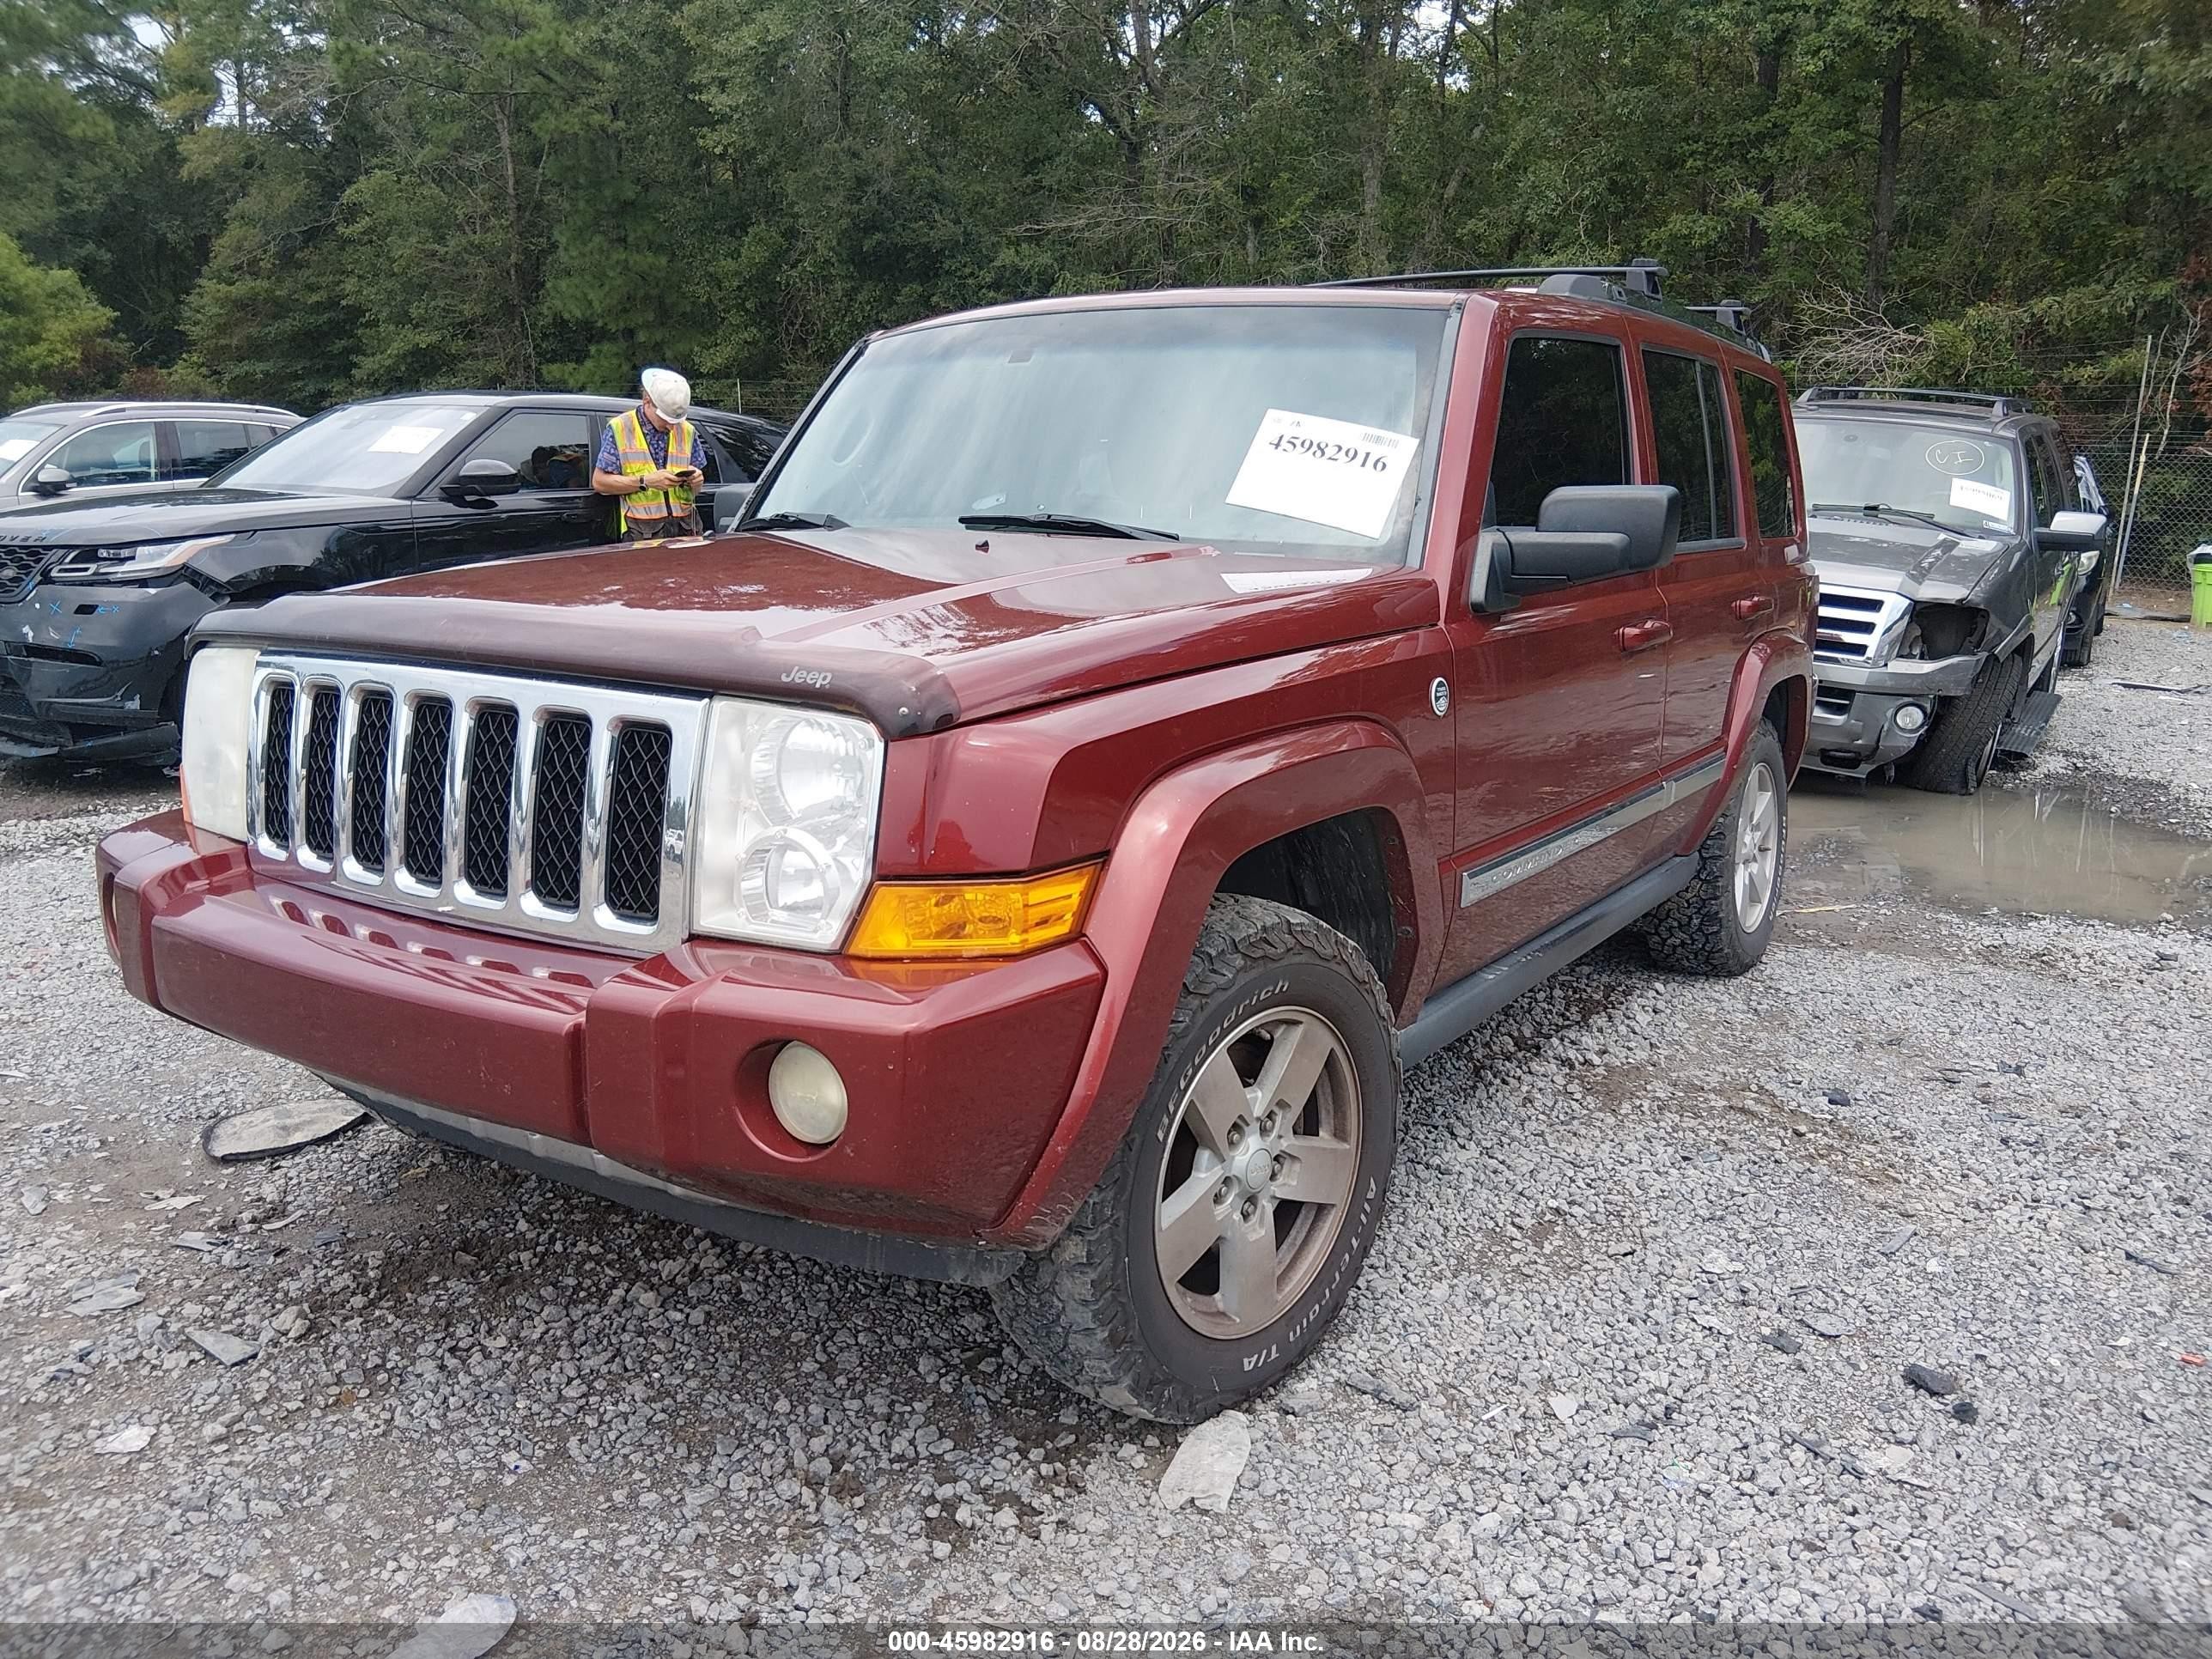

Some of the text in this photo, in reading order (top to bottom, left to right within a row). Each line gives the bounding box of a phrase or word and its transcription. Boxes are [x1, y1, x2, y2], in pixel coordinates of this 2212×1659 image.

[1268, 434, 1389, 472] 45982916
[781, 665, 833, 689] Jeep
[1492, 836, 1582, 884] COMMAND
[1157, 978, 1290, 1143] BFGoodrich
[1243, 1175, 1377, 1372] All-Terrain T/A
